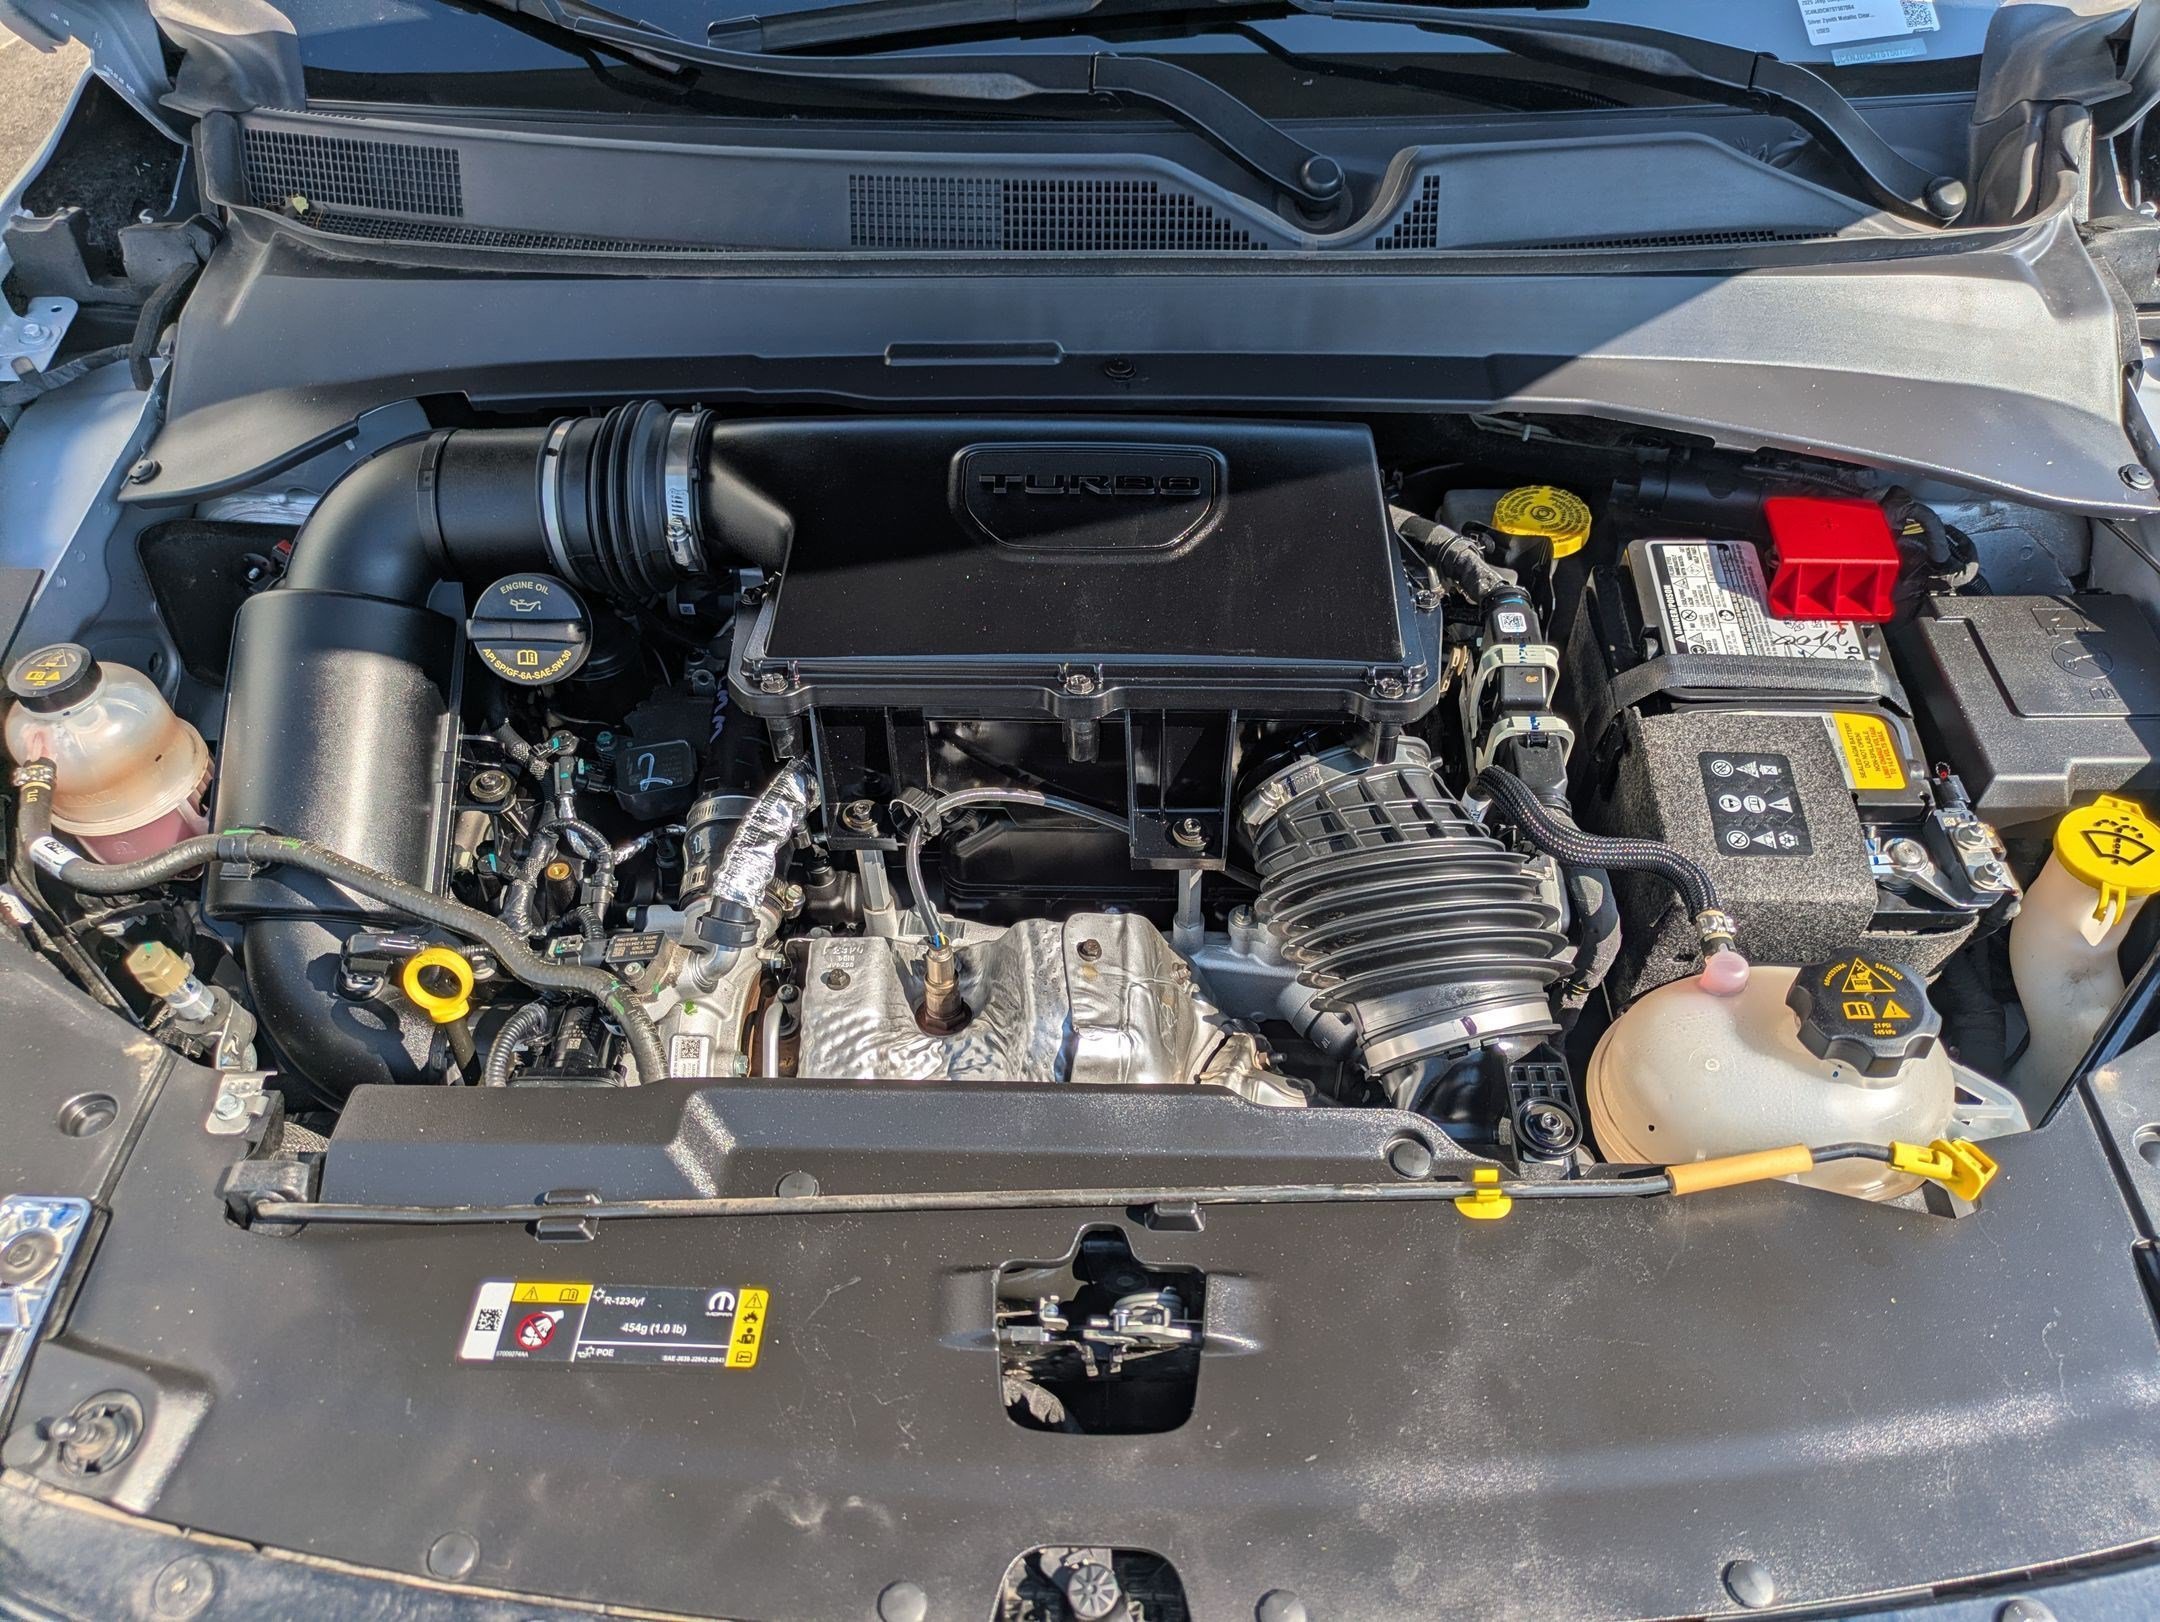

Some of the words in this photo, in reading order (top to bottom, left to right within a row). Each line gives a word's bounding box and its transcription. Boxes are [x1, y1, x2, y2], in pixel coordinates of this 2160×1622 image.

[978, 474, 1201, 496] TURBO
[500, 581, 534, 595] ENGINE
[535, 583, 550, 595] OIL
[1664, 585, 1683, 635] DANGER/POISON
[483, 648, 497, 663] API
[1843, 722, 1856, 743] BATTERY
[1850, 745, 1859, 756] AGM
[1859, 749, 1868, 758] NOT
[1862, 730, 1880, 771] NON-SPILLABLE
[1854, 758, 1867, 778] SEALED
[1862, 760, 1871, 768] DO
[604, 1297, 645, 1308] R-1234yf
[620, 1322, 649, 1335] 454g
[649, 1323, 670, 1336] (1.0
[671, 1323, 688, 1336] lb)
[596, 1348, 615, 1357] POE
